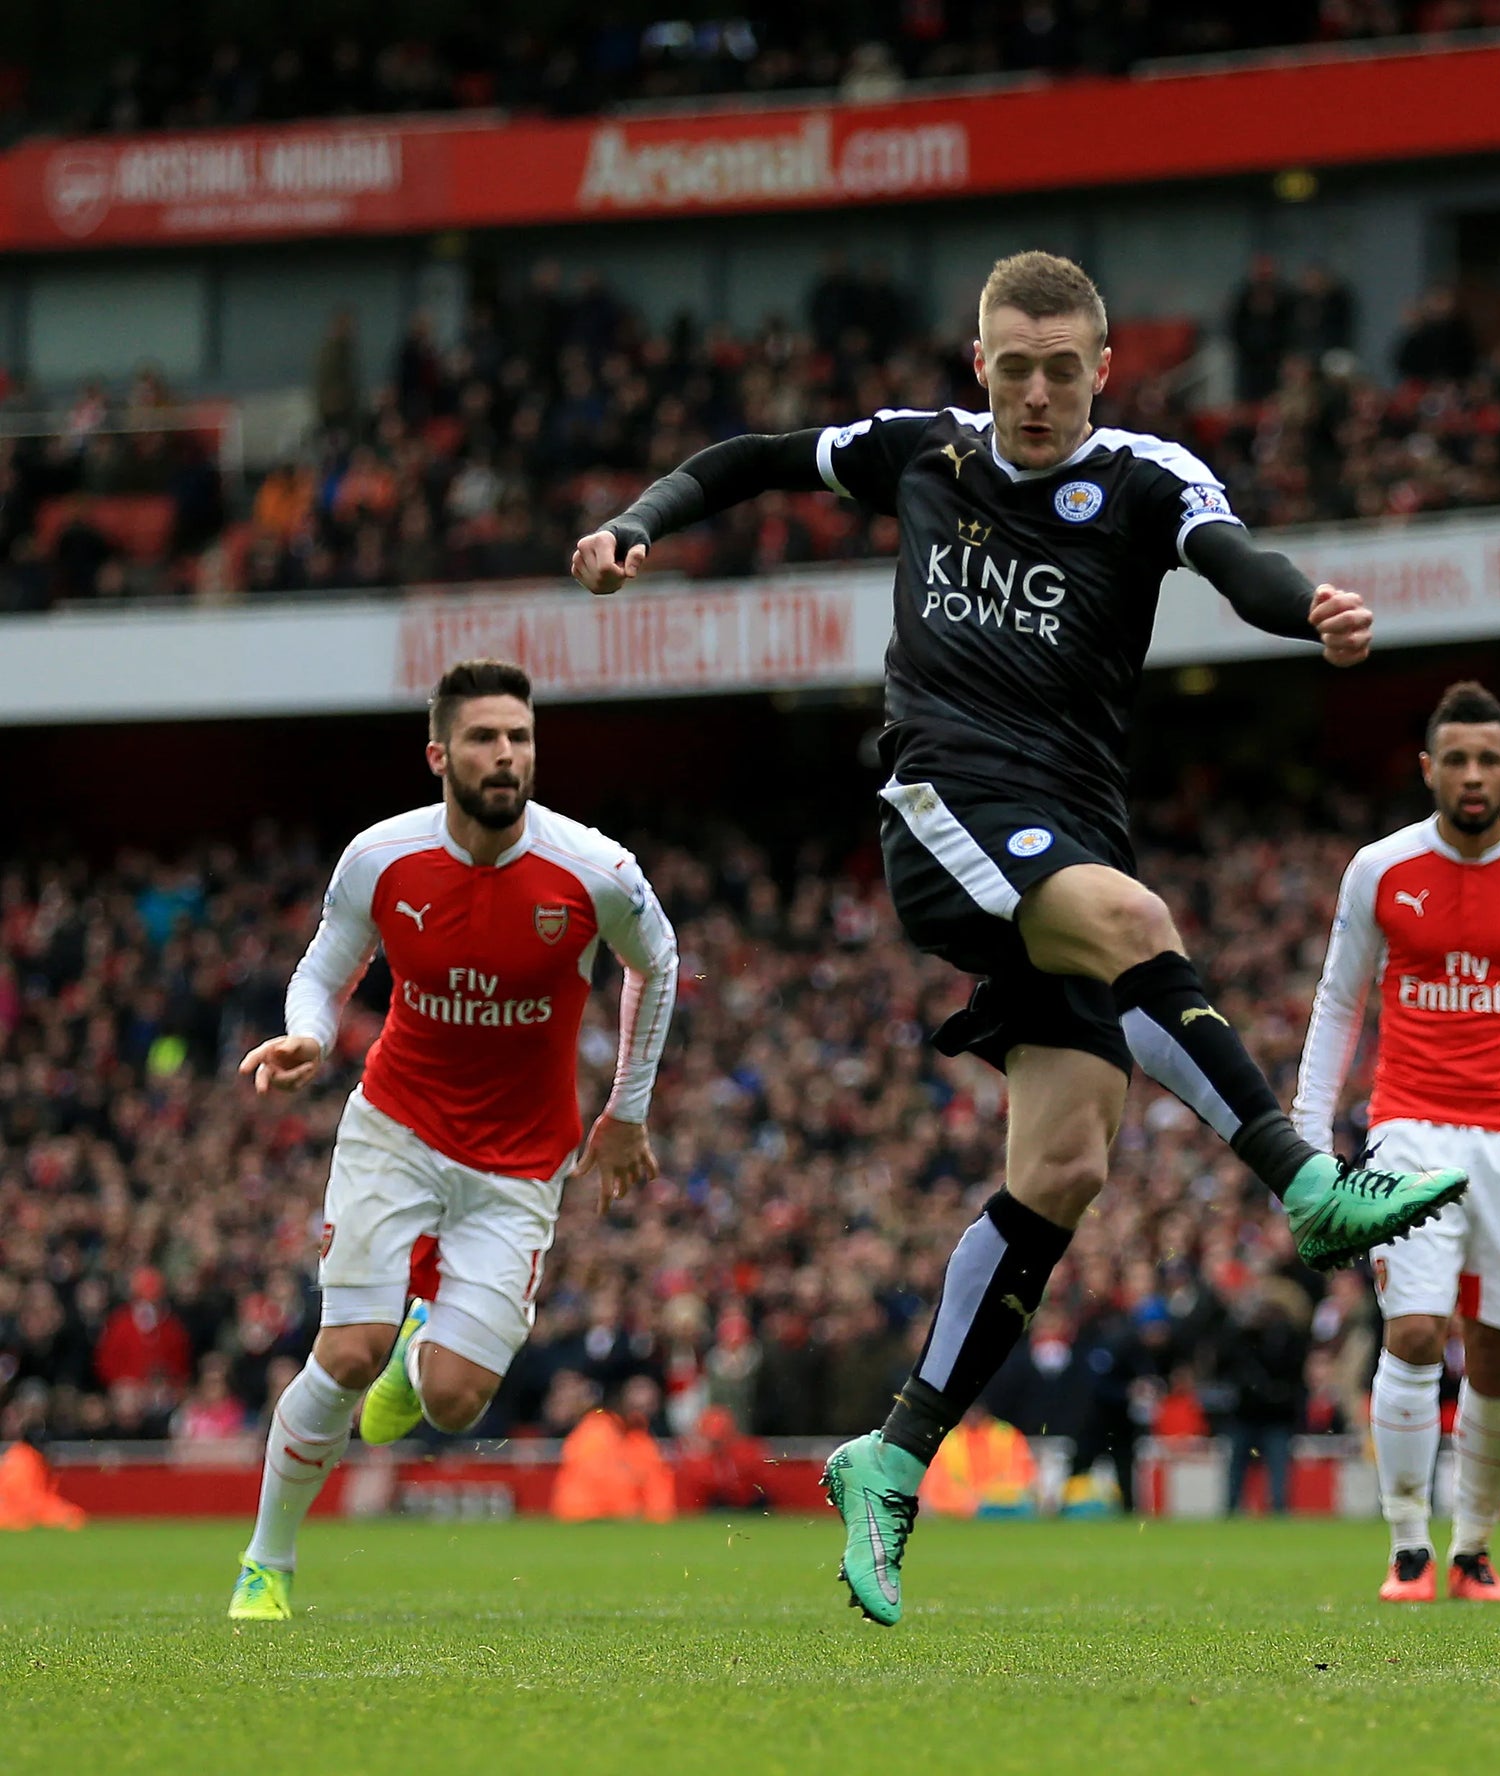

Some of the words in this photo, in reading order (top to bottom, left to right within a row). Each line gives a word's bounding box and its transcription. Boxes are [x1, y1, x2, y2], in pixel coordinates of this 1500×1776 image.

[576, 108, 969, 208] Arsenal.com
[926, 545, 1066, 607] KING
[923, 591, 1060, 645] POWER
[449, 967, 498, 998] Fly
[1445, 952, 1490, 982] Fly
[402, 979, 552, 1027] Emirates
